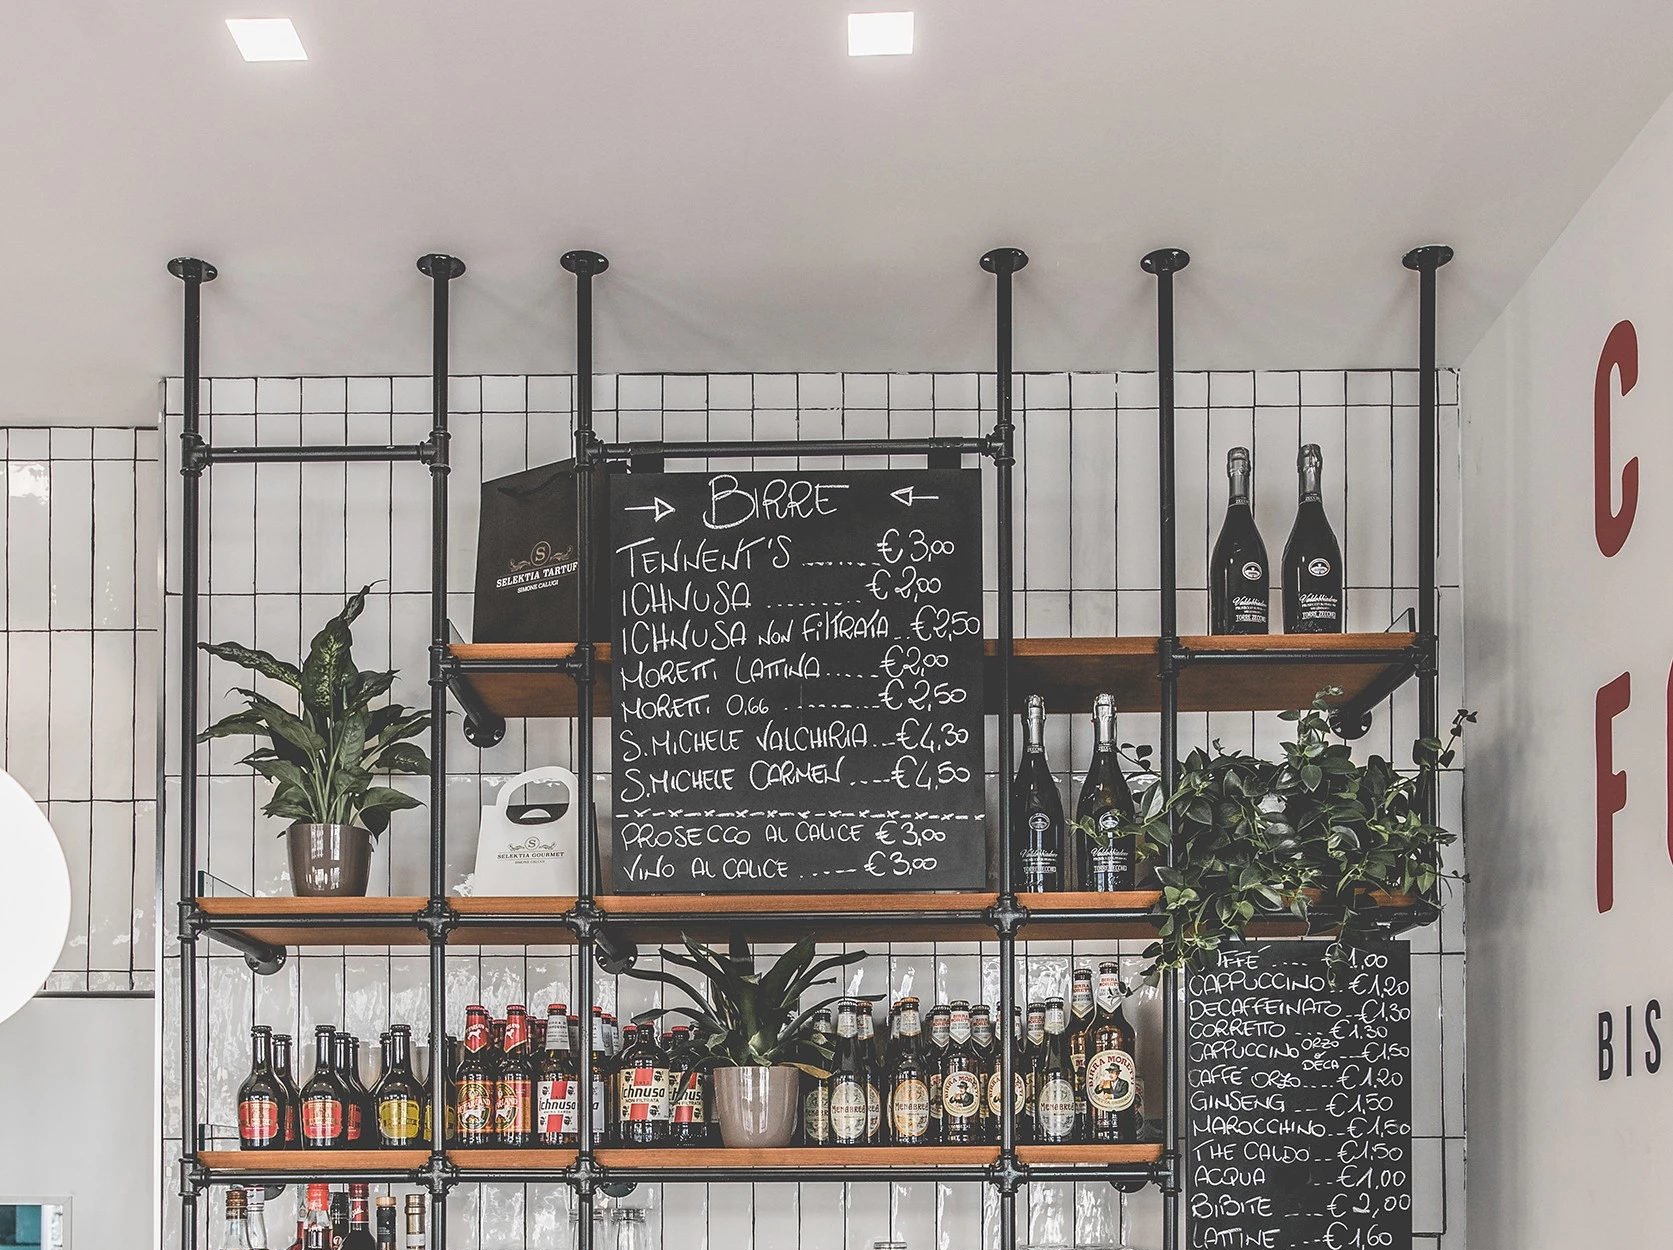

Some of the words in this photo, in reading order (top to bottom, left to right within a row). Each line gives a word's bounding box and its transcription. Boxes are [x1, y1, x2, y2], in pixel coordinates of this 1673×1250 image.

[703, 474, 849, 529] BIRRE
[616, 535, 792, 577] TENNENT'S
[496, 571, 540, 588] SELEKTIA
[623, 581, 751, 616] ICHNUSA
[623, 620, 747, 652] ICHNUSA
[758, 619, 794, 646] NON
[621, 657, 717, 690] MORETTI
[621, 693, 710, 722] MORETTI
[756, 719, 869, 750] VALCHIRIA
[749, 755, 845, 791] CARMEN
[1595, 660, 1673, 914] F
[621, 822, 751, 851] PROSECCO
[795, 821, 866, 843] CALICE
[623, 853, 675, 882] VINO
[722, 857, 790, 880] CALICE
[1189, 970, 1325, 997] CAPPUCCINO
[1189, 997, 1342, 1021] DECAFFEINATO
[1189, 1018, 1286, 1039] CORRETTO
[1598, 998, 1662, 1081] BIS
[1189, 1039, 1300, 1062] CAPPUCCINO
[1301, 1037, 1340, 1050] ORZO
[1088, 1058, 1106, 1088] BIRRA
[1107, 1055, 1136, 1086] MORETTI
[1301, 1059, 1340, 1071] DECA
[539, 1097, 576, 1112] ichnusa
[621, 1083, 665, 1100] ichnusa
[1190, 1090, 1286, 1112] GINSENG
[1193, 1115, 1326, 1138] MAROCCHINO
[1192, 1139, 1237, 1162] THE
[1244, 1141, 1310, 1163] CALDO
[1194, 1165, 1266, 1187] ACQUA
[1191, 1193, 1273, 1219] BIBITE
[1192, 1223, 1281, 1249] LATTINE
